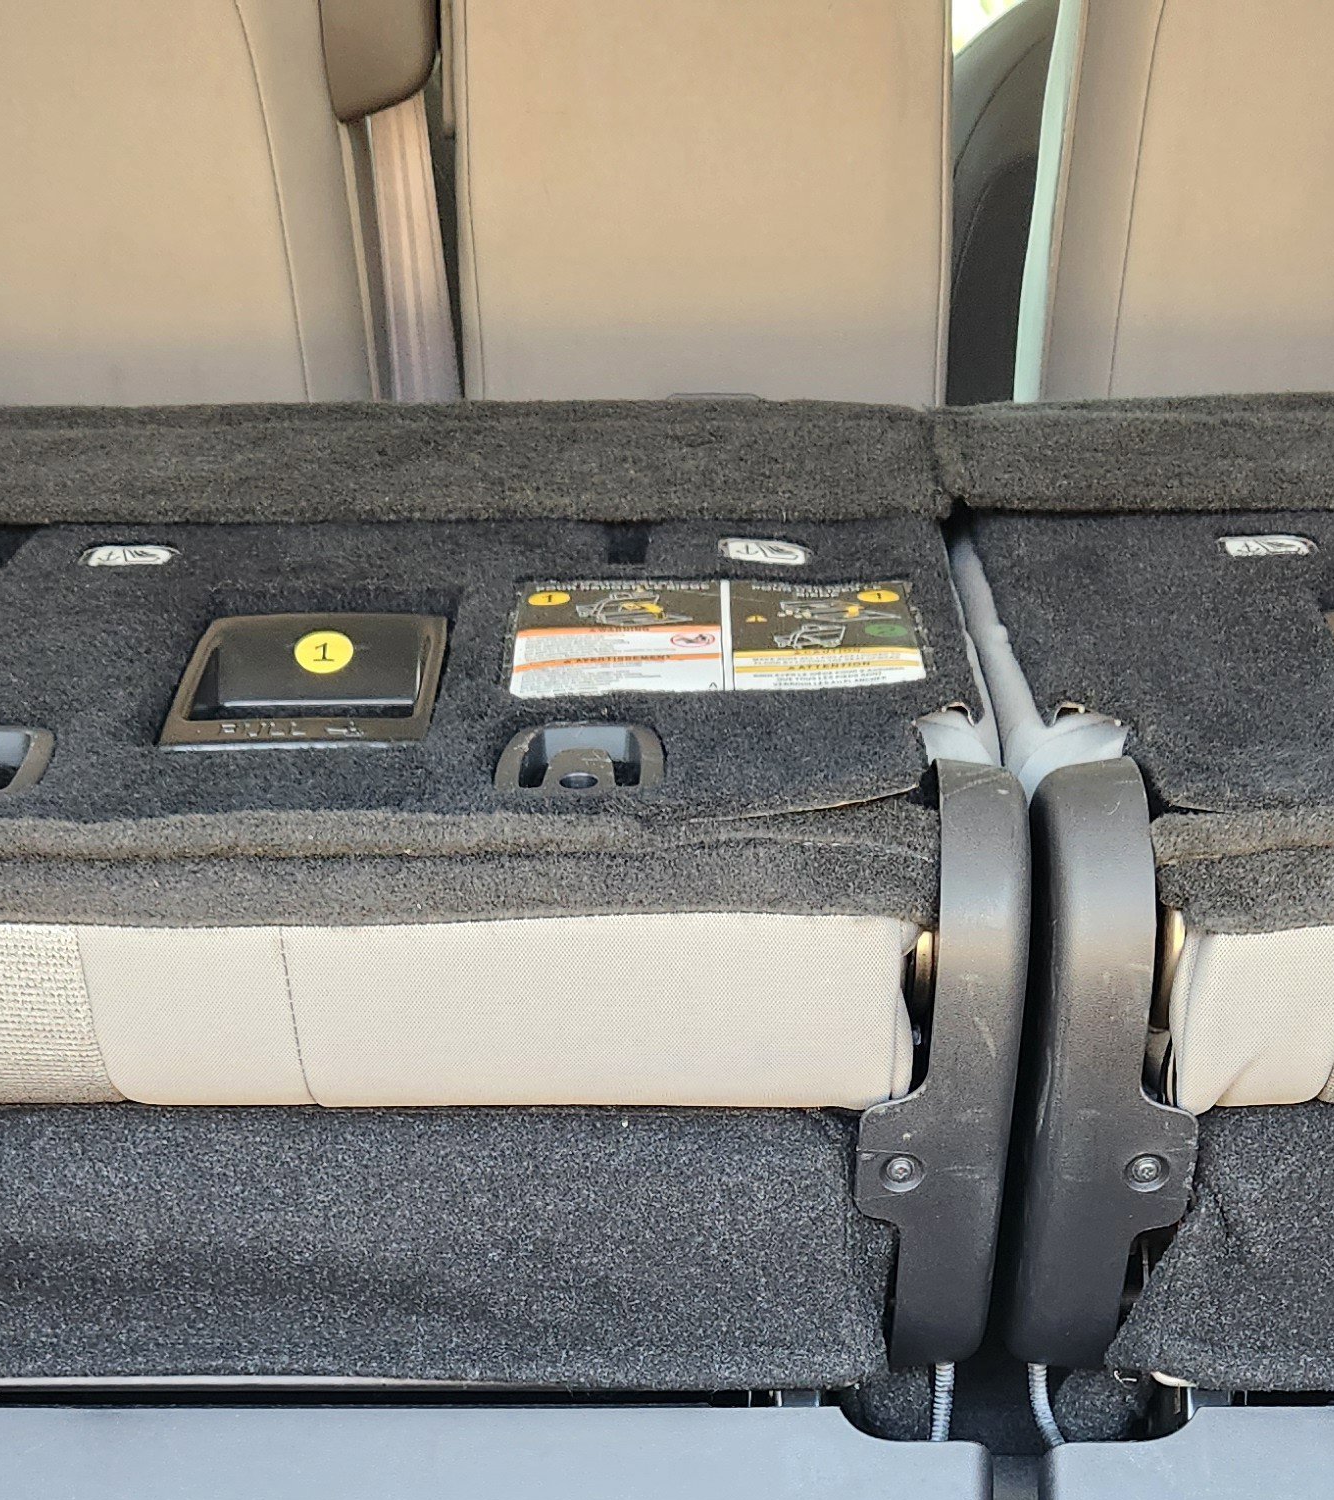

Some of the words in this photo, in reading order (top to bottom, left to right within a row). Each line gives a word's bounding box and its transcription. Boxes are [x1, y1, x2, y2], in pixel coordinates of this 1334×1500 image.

[313, 642, 335, 662] 1
[799, 661, 871, 670] ATTENTION
[219, 721, 306, 738] PULL
